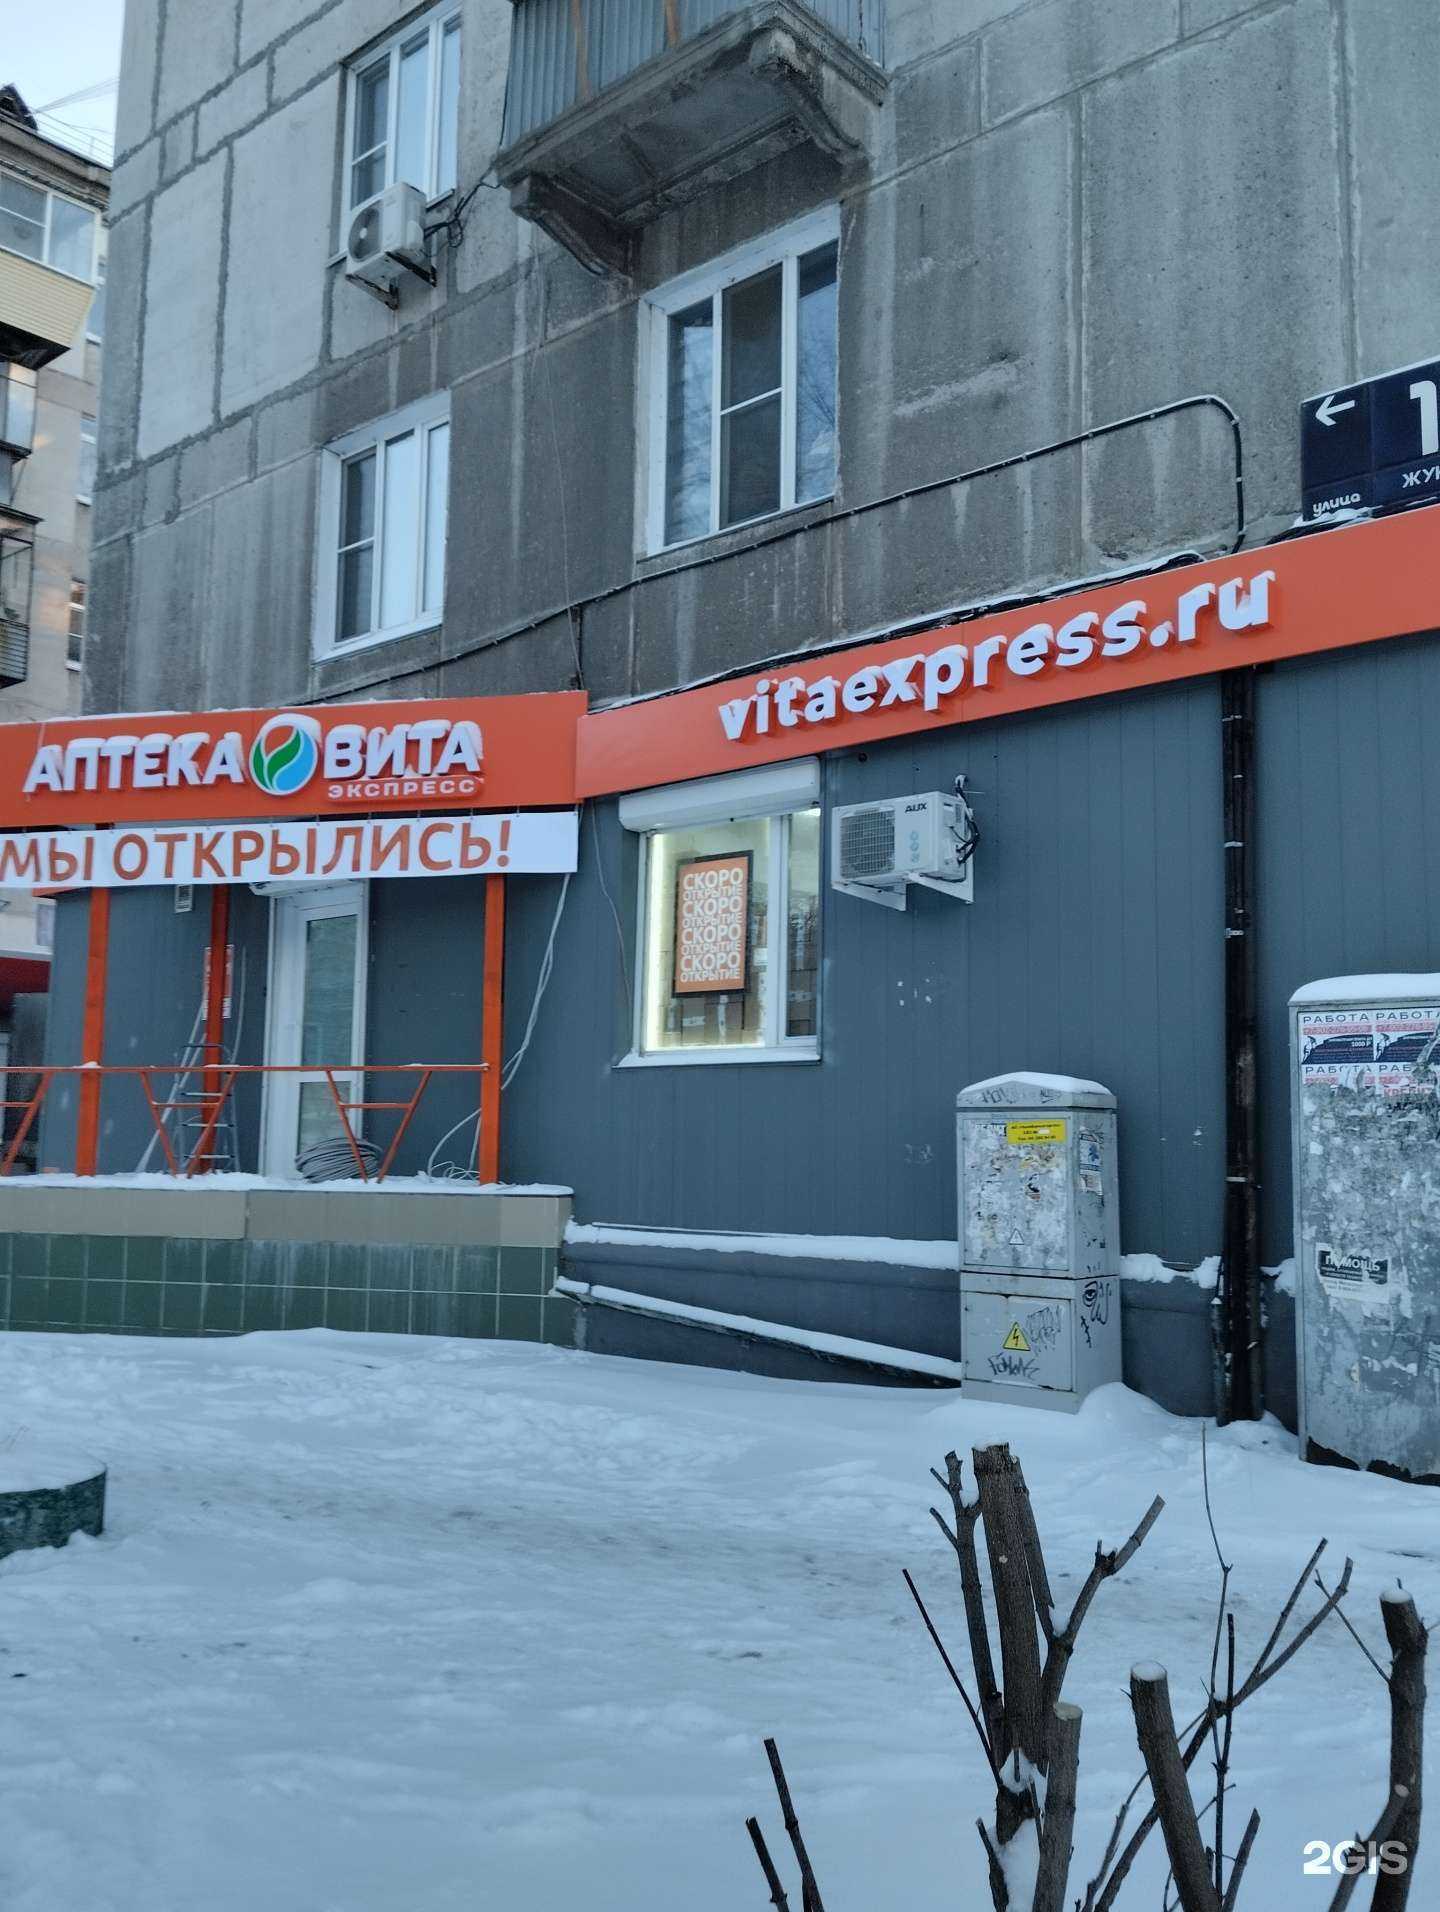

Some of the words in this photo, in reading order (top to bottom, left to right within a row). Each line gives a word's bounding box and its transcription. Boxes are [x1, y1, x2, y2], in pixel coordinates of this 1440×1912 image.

[1409, 380, 1439, 456] 1
[1312, 493, 1361, 518] улица
[719, 570, 1277, 741] vitaexpress.ru
[23, 731, 245, 794] АПТЕКА
[323, 720, 484, 780] ВИТА
[327, 778, 476, 799] ЭКСПРЕСС
[905, 803, 927, 813] AUX
[0, 836, 95, 882] МЫ
[113, 819, 511, 881] ОТКРЫЛИСЬ!
[683, 868, 743, 890] СКОРО
[682, 884, 743, 901] ОТКРЫТИЕ
[682, 896, 742, 917] СКОРО
[681, 911, 742, 929] ОТКРЫТИЕ
[681, 924, 741, 945] СКОРО
[680, 940, 741, 957] ОТКРЫТИЕ
[680, 951, 740, 973] СКОРО
[679, 967, 740, 983] ОТКРЫТИЕ
[1303, 1013, 1369, 1024] РАБОТА
